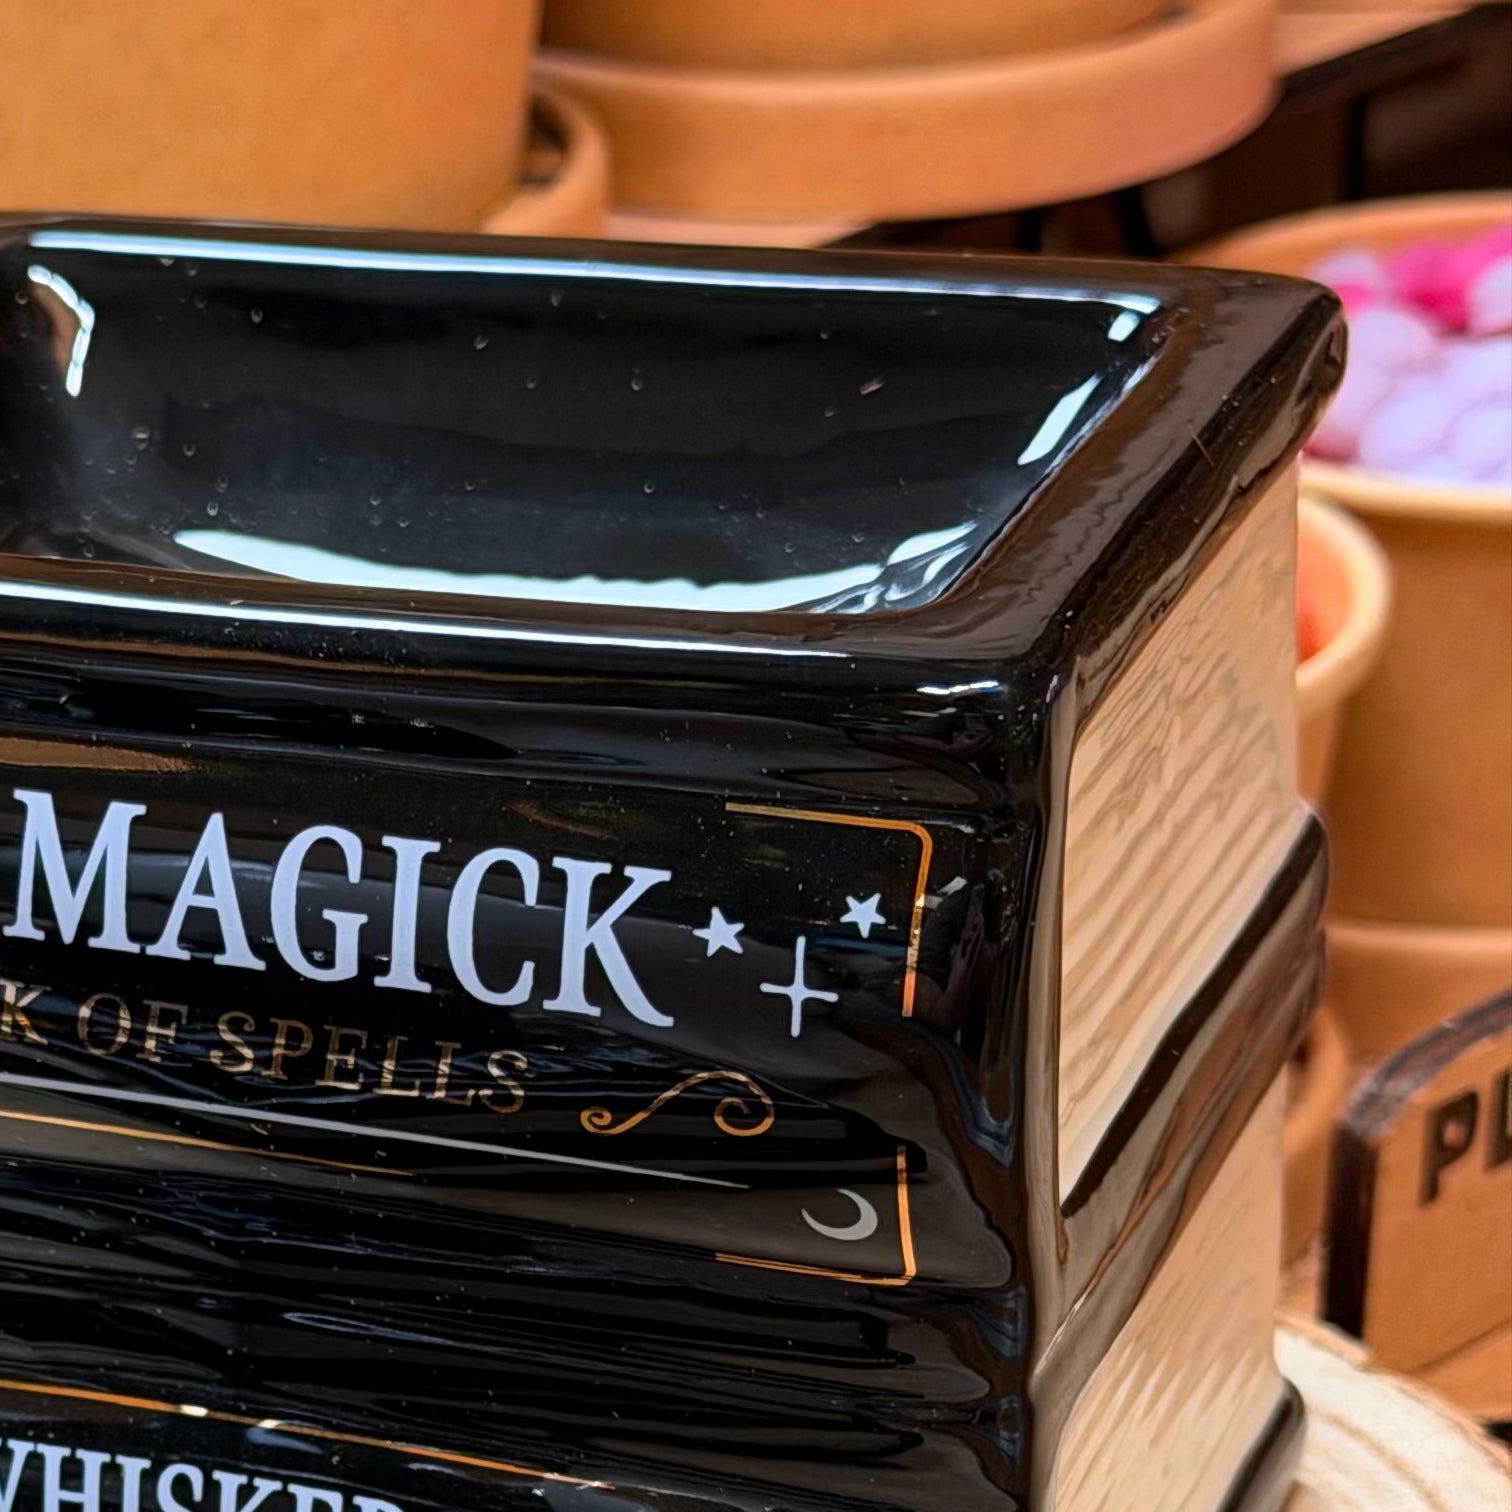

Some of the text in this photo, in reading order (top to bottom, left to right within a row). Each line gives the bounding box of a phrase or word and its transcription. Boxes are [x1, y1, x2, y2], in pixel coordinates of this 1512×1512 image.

[1, 787, 674, 1028] MAGICK
[76, 993, 190, 1062] OF
[208, 1010, 532, 1115] SPELLS
